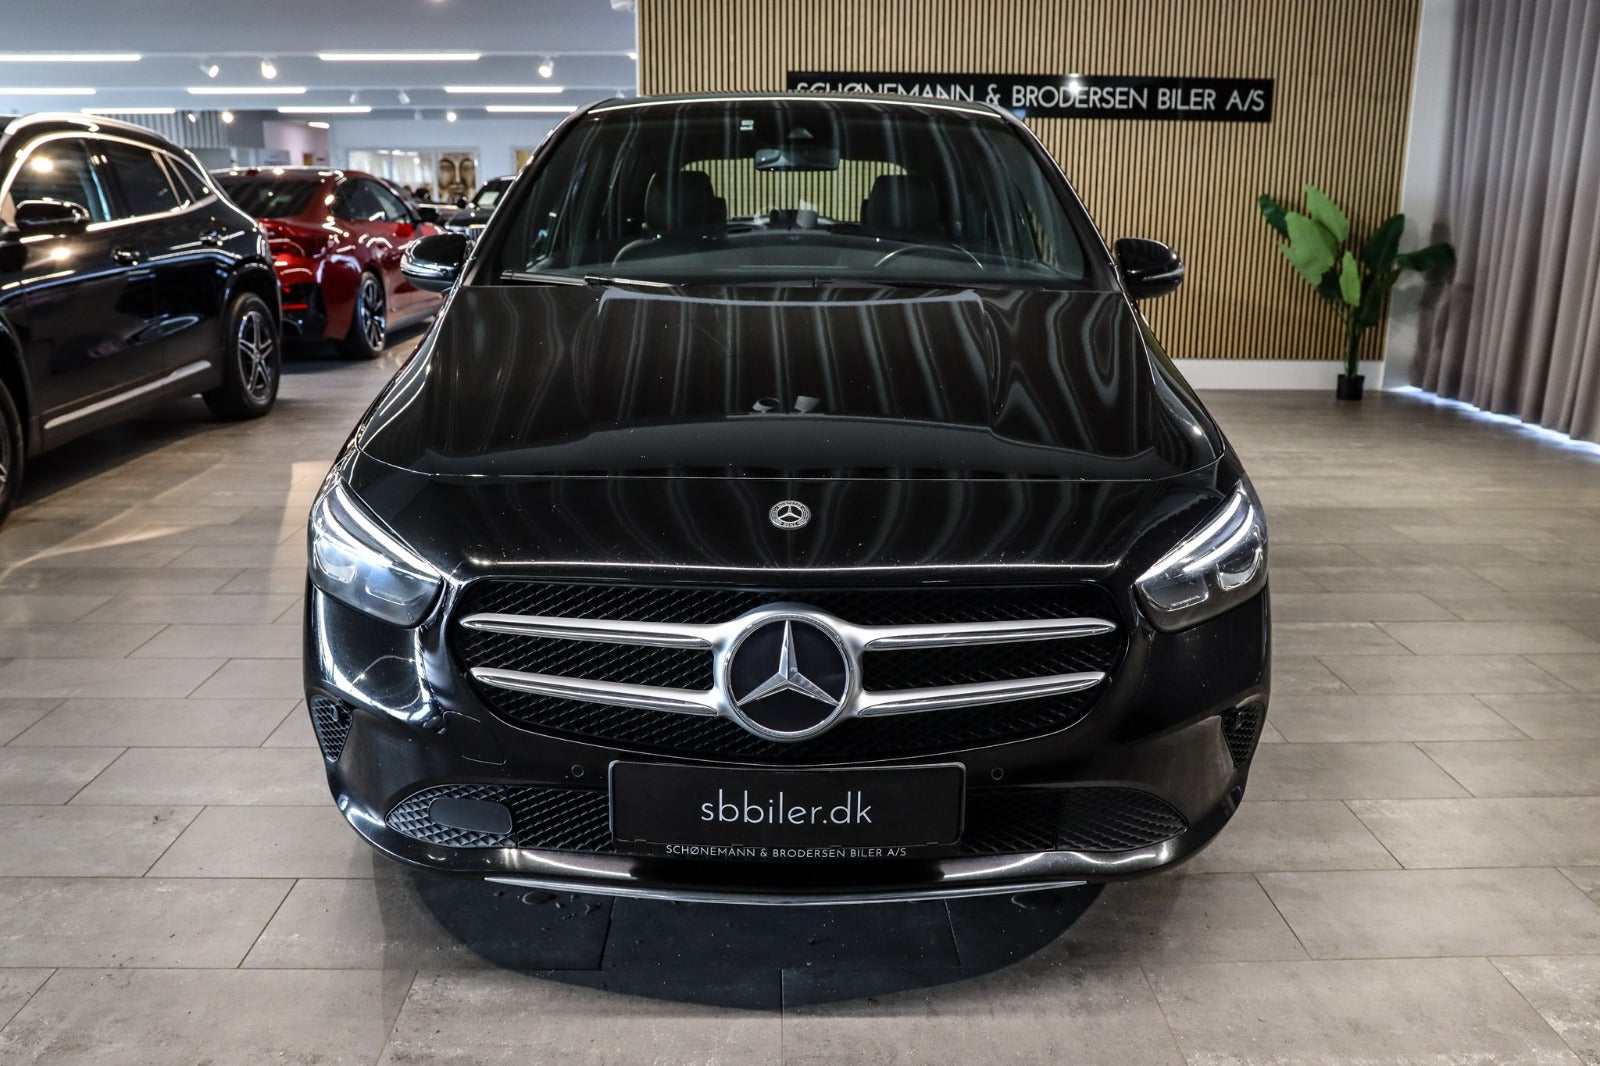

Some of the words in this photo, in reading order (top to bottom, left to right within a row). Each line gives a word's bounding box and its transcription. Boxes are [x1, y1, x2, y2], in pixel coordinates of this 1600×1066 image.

[986, 83, 1001, 104] &
[1012, 85, 1147, 109] BRODERSEN
[1157, 88, 1215, 110] BILER
[1225, 90, 1265, 112] A/S
[701, 788, 872, 824] sbbiler.dk
[666, 844, 755, 857] SCHØNEMANN
[760, 848, 768, 857] &
[772, 848, 846, 858] BRODERSEN
[850, 848, 883, 857] BILER
[887, 847, 907, 857] A/S
